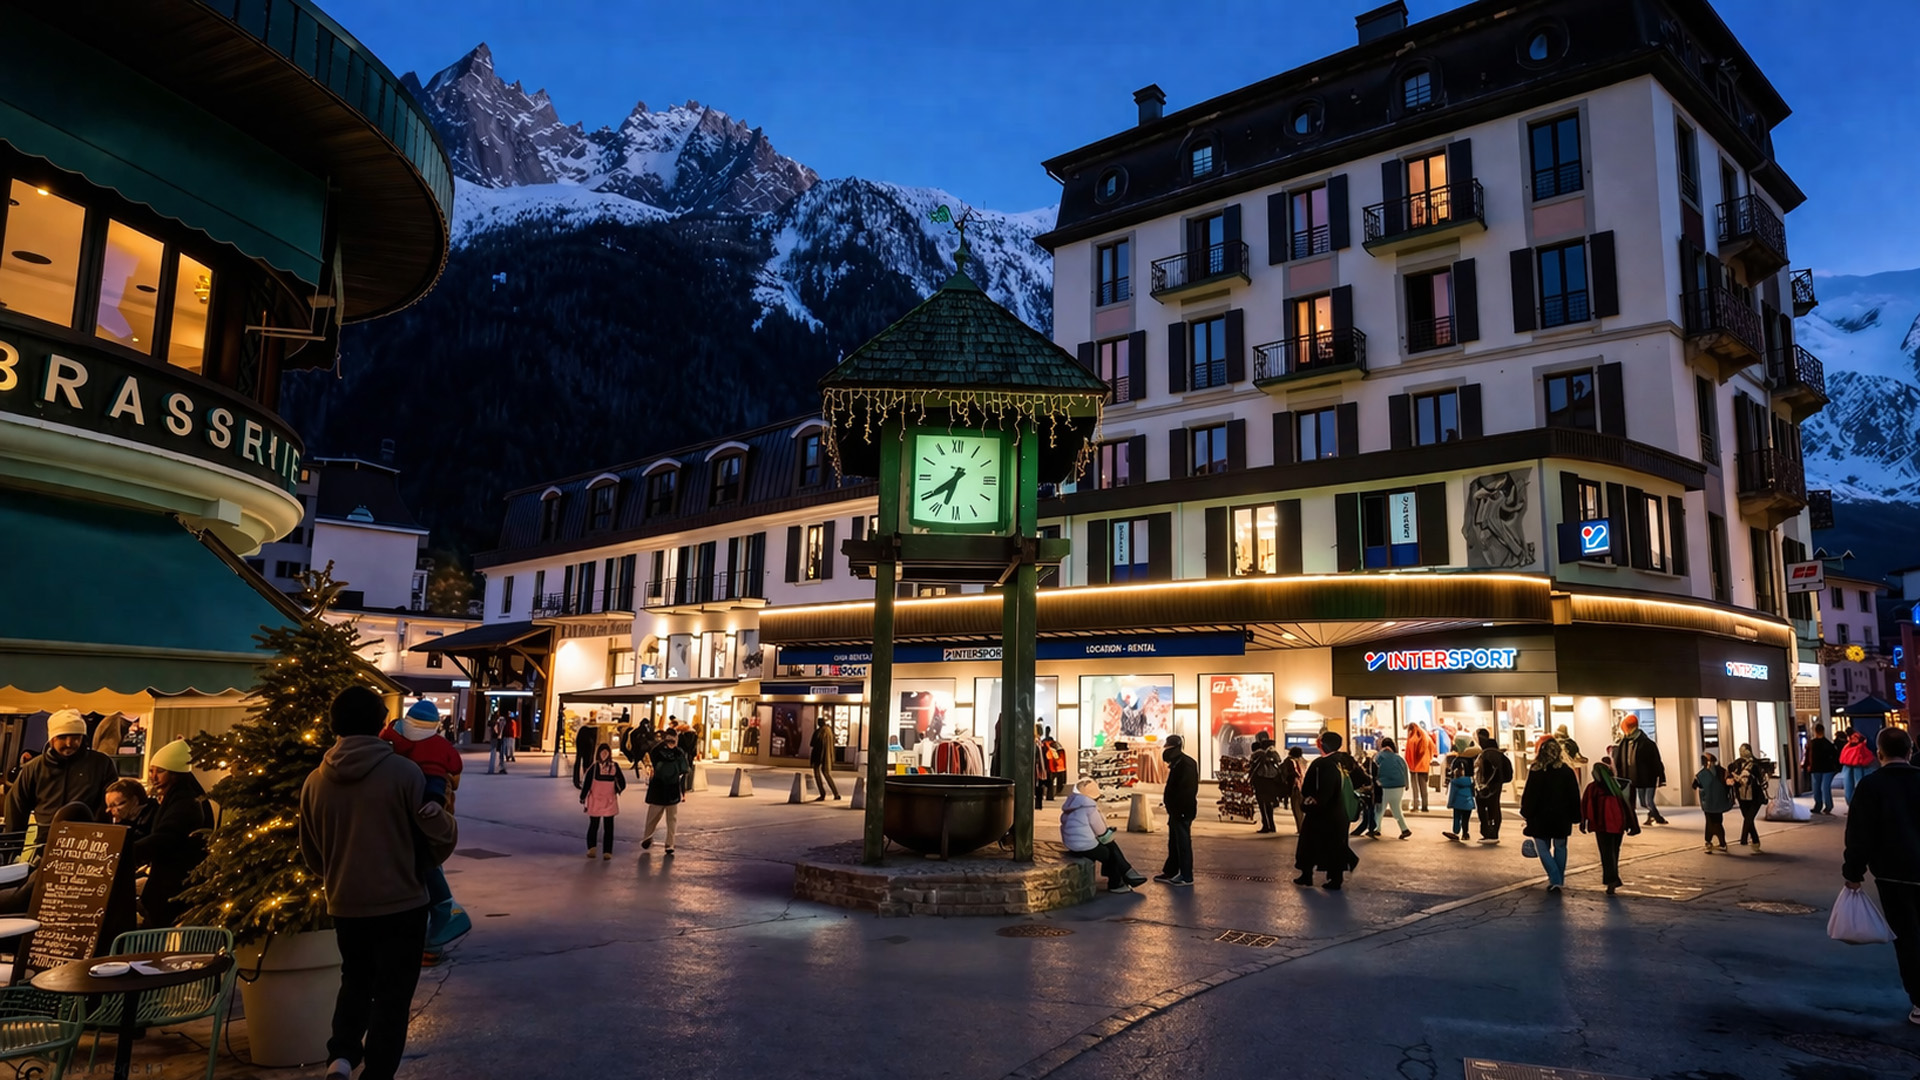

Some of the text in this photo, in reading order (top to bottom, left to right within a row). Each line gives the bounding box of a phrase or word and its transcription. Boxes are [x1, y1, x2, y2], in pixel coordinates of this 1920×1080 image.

[952, 648, 1003, 659] INTERSPOR
[1085, 644, 1122, 653] LOCATION
[1127, 643, 1156, 653] RENTAL
[1387, 648, 1517, 671] INTERSPORT
